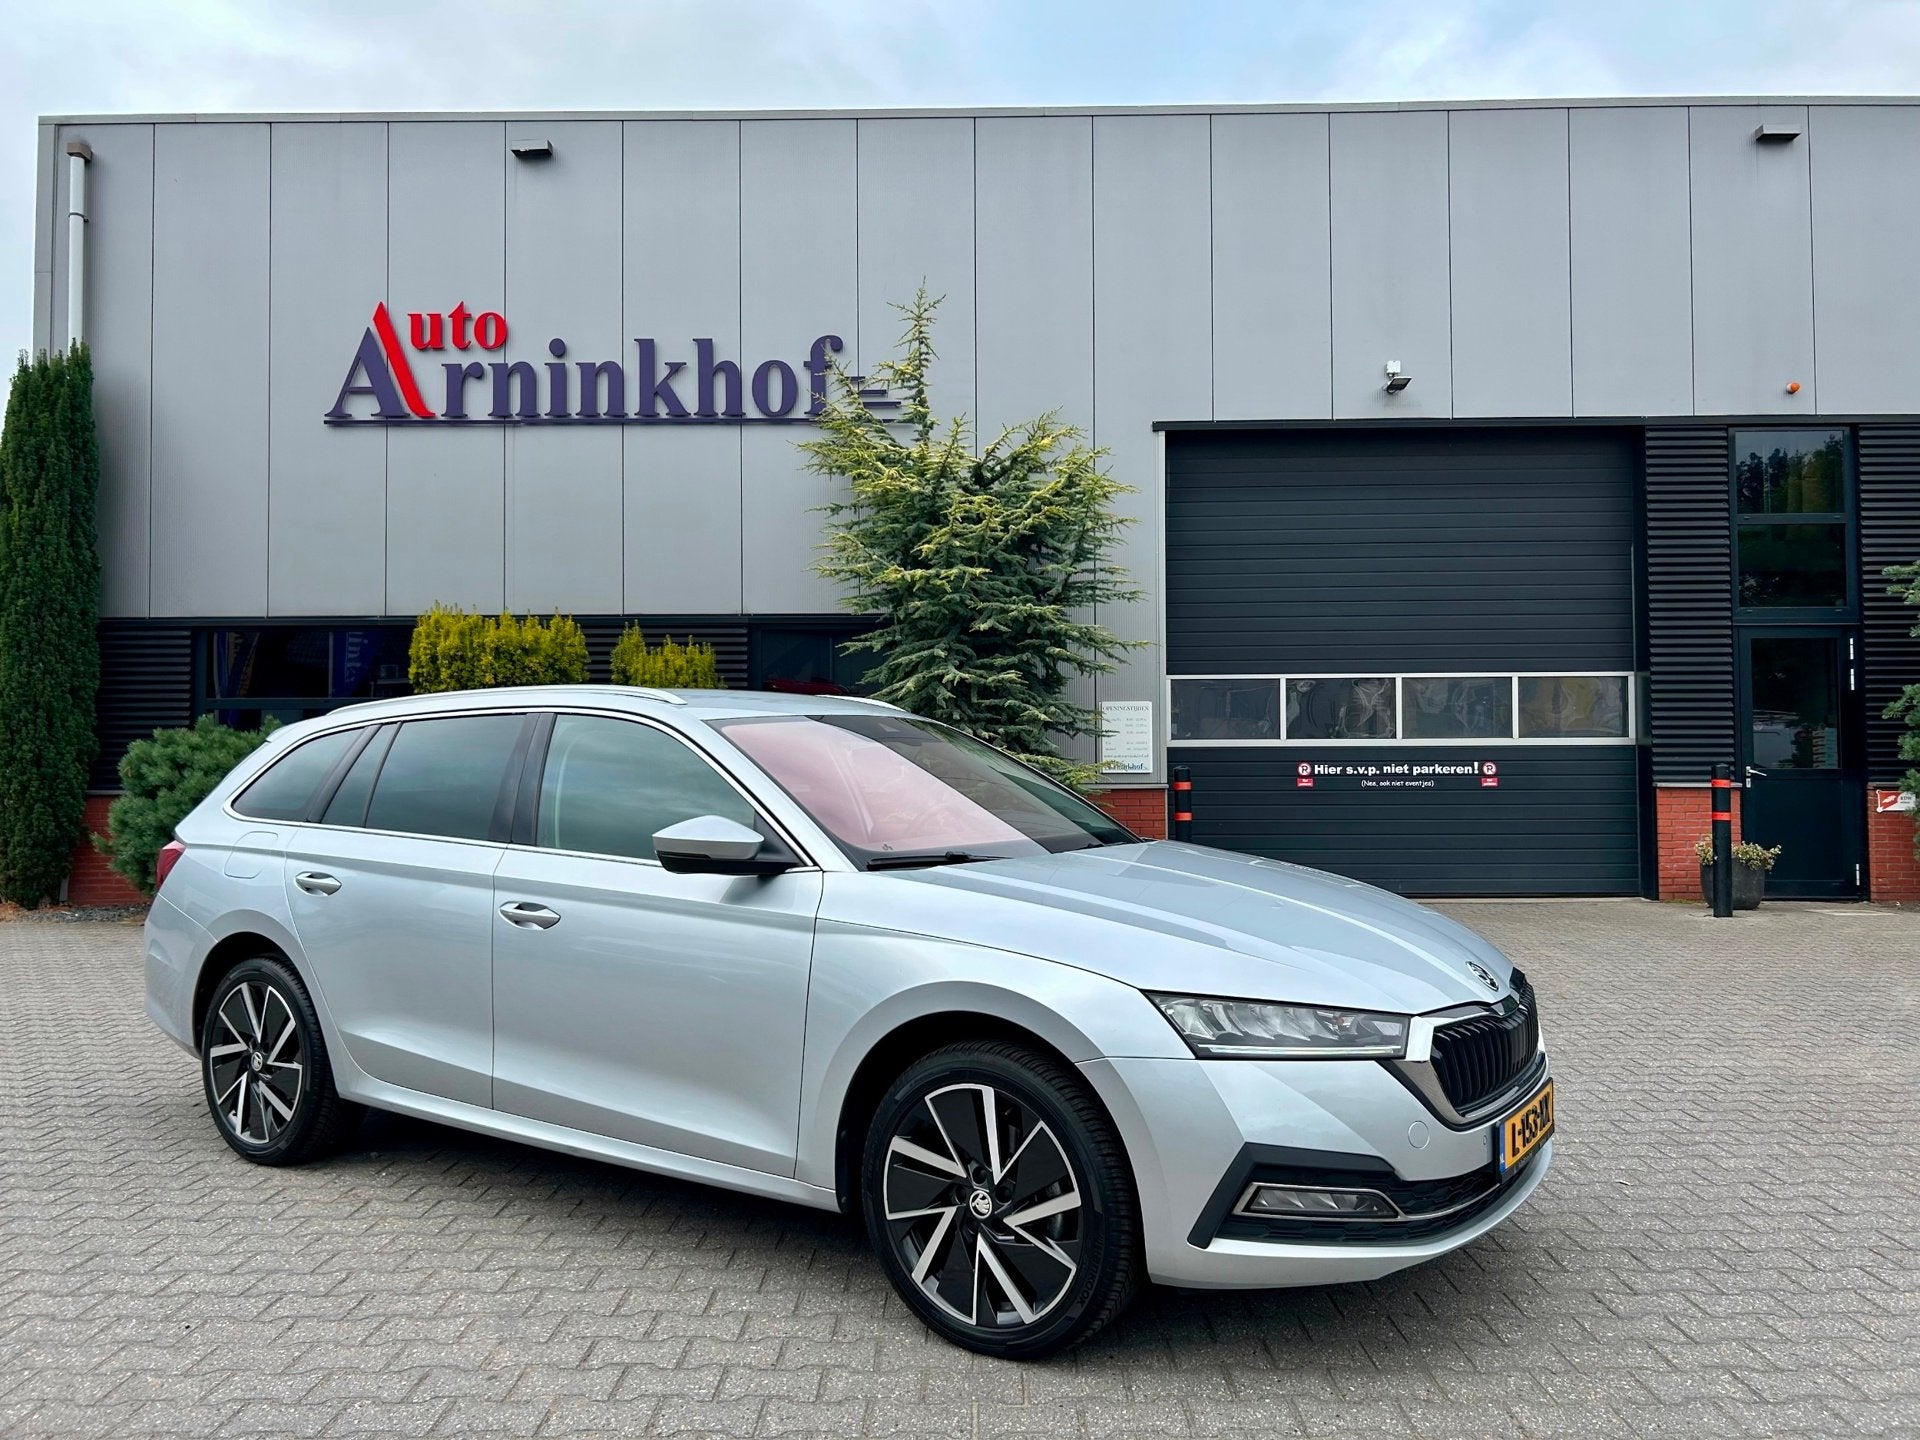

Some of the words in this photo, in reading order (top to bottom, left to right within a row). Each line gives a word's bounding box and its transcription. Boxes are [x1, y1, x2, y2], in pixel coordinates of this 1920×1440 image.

[325, 327, 843, 418] Arninkhof
[1314, 764, 1343, 775] Hier
[1345, 765, 1380, 776] s.v.p.
[1383, 763, 1409, 774] niet
[1412, 761, 1479, 776] parkeren!
[1379, 779, 1391, 787] ook
[1391, 779, 1404, 787] niet
